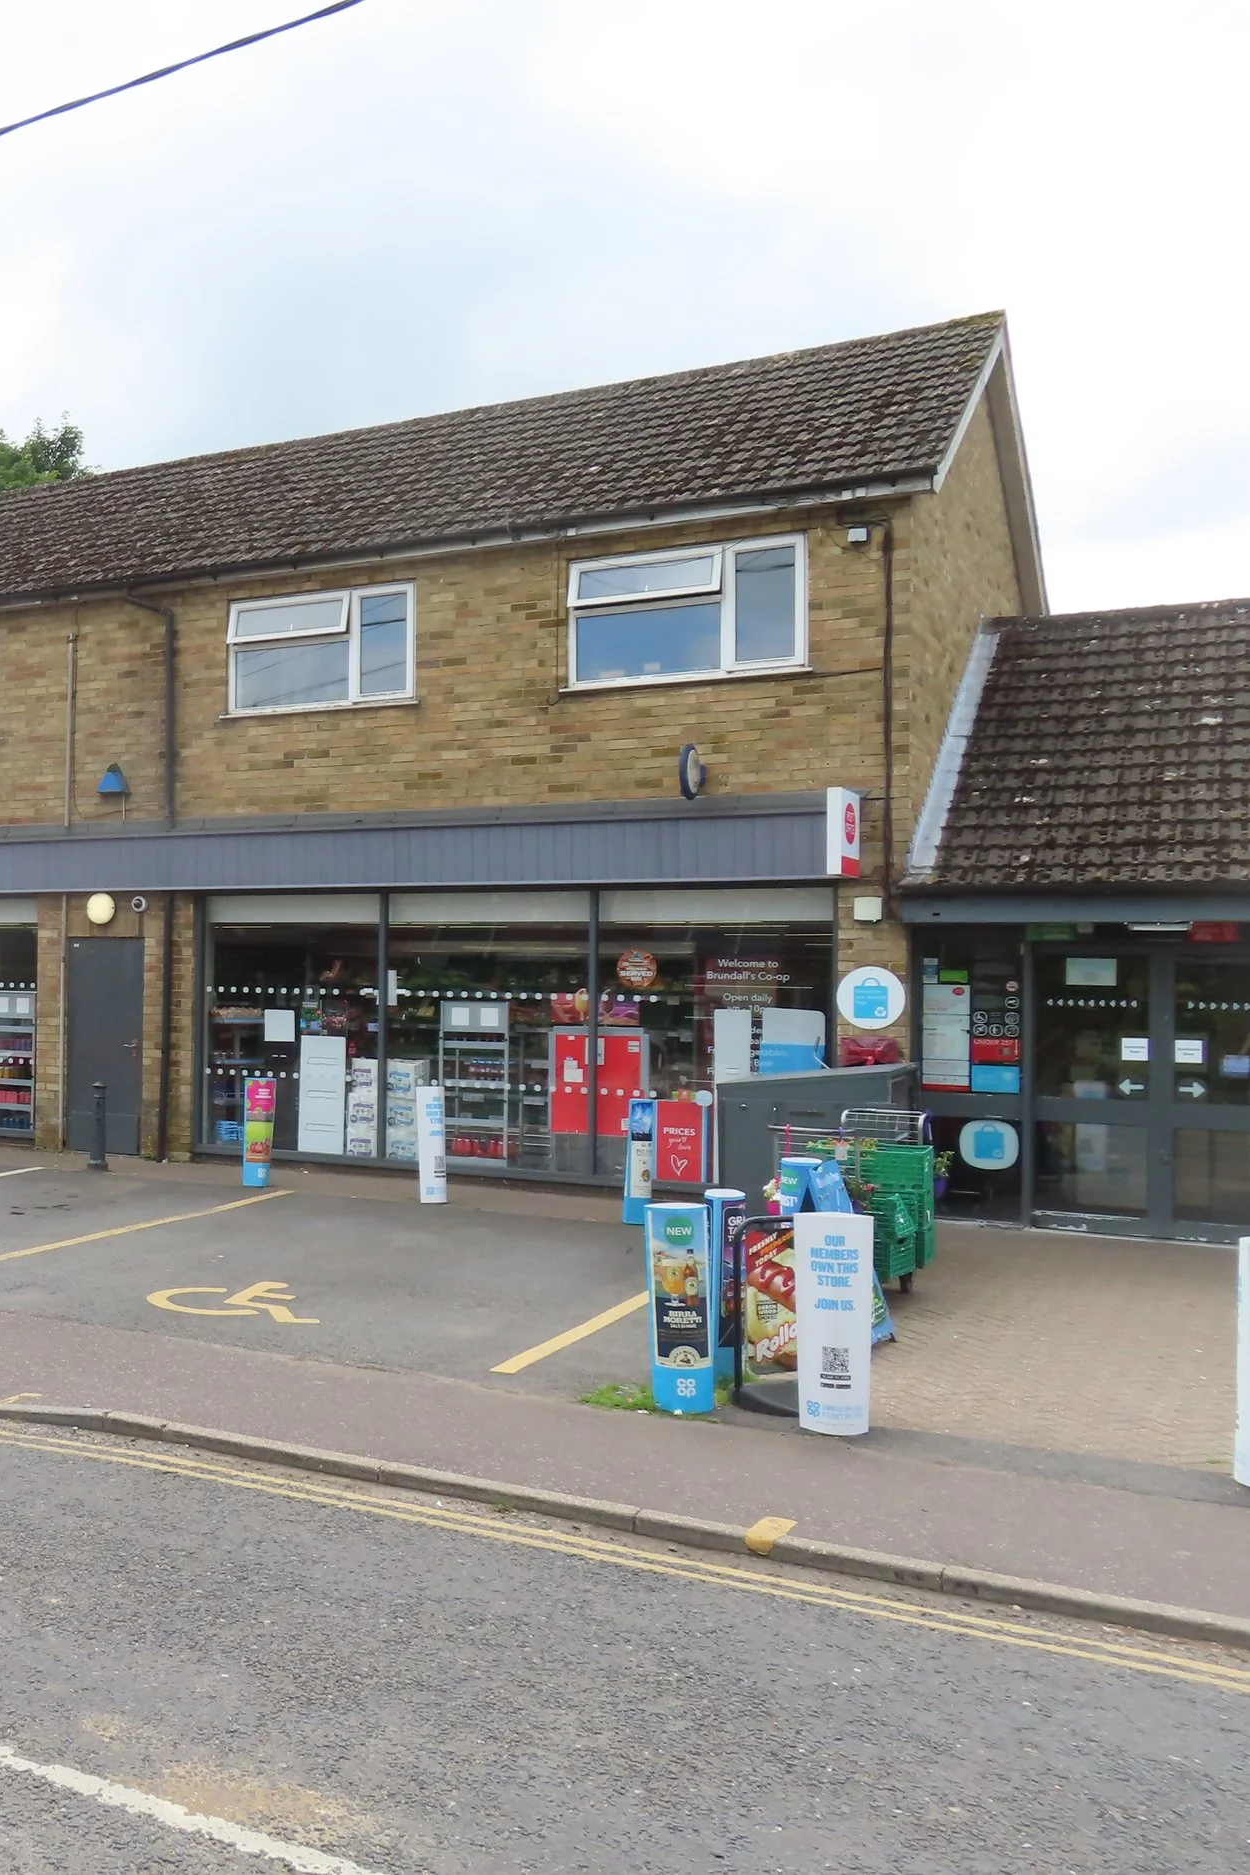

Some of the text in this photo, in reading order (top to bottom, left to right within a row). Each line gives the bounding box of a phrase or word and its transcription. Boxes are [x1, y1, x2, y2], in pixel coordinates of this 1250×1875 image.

[718, 959, 779, 968] Welcome to
[706, 971, 790, 983] Brundall's Co-op
[723, 993, 773, 1003] Open daily
[749, 1005, 765, 1014] 10p
[663, 1126, 696, 1136] PRICES
[666, 1227, 692, 1236] NEW
[824, 1235, 846, 1246] OUR
[755, 1249, 778, 1267] TODAY
[810, 1247, 859, 1260] MEMBERS
[811, 1261, 859, 1274] OWN THIS
[817, 1275, 852, 1287] STORE.
[814, 1298, 838, 1310] JOIN
[663, 1316, 703, 1324] MORETTI
[756, 1322, 798, 1363] Rollo
